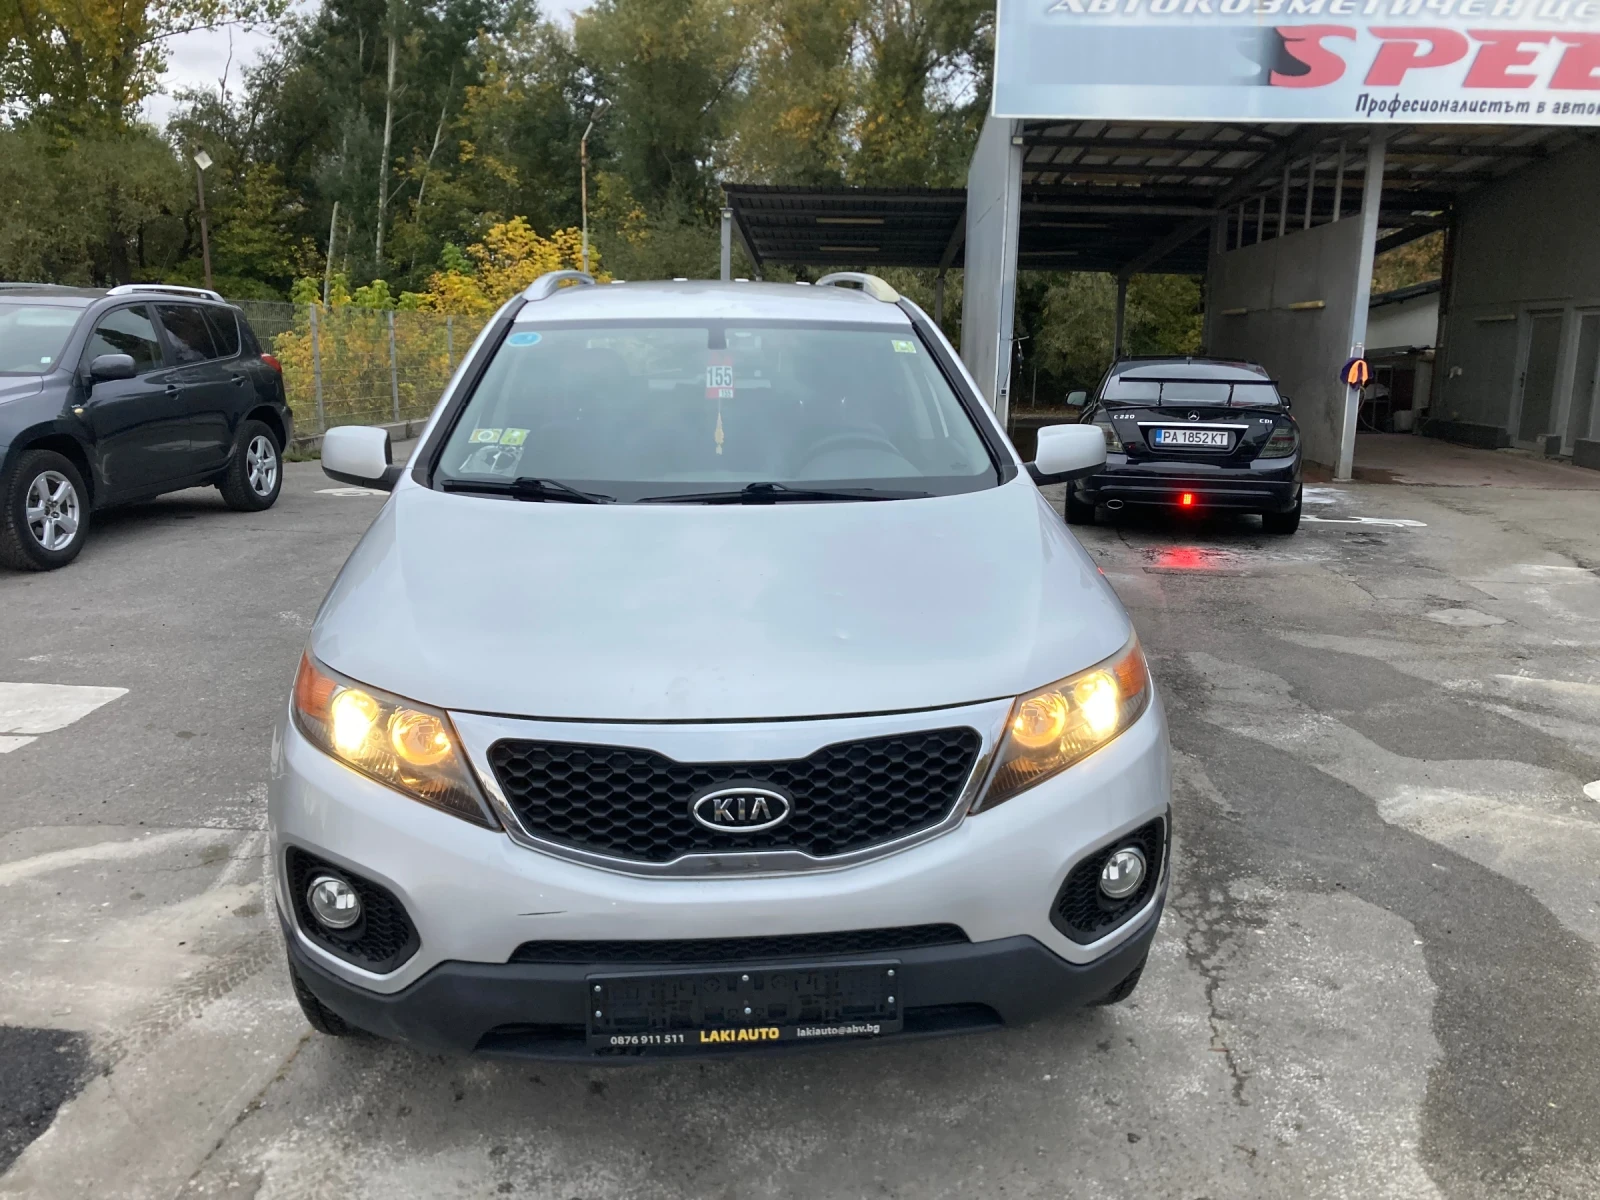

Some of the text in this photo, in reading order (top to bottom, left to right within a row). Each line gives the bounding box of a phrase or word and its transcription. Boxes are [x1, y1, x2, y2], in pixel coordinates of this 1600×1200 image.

[1355, 93, 1600, 118] Професионалистът в авто
[707, 367, 732, 386] 155
[1182, 431, 1209, 443] 1852
[712, 797, 772, 821] KIA
[610, 1035, 639, 1045] 0876
[640, 1035, 661, 1044] 911
[664, 1034, 684, 1044] 511
[797, 1023, 880, 1036] lakiauto@abv.bg
